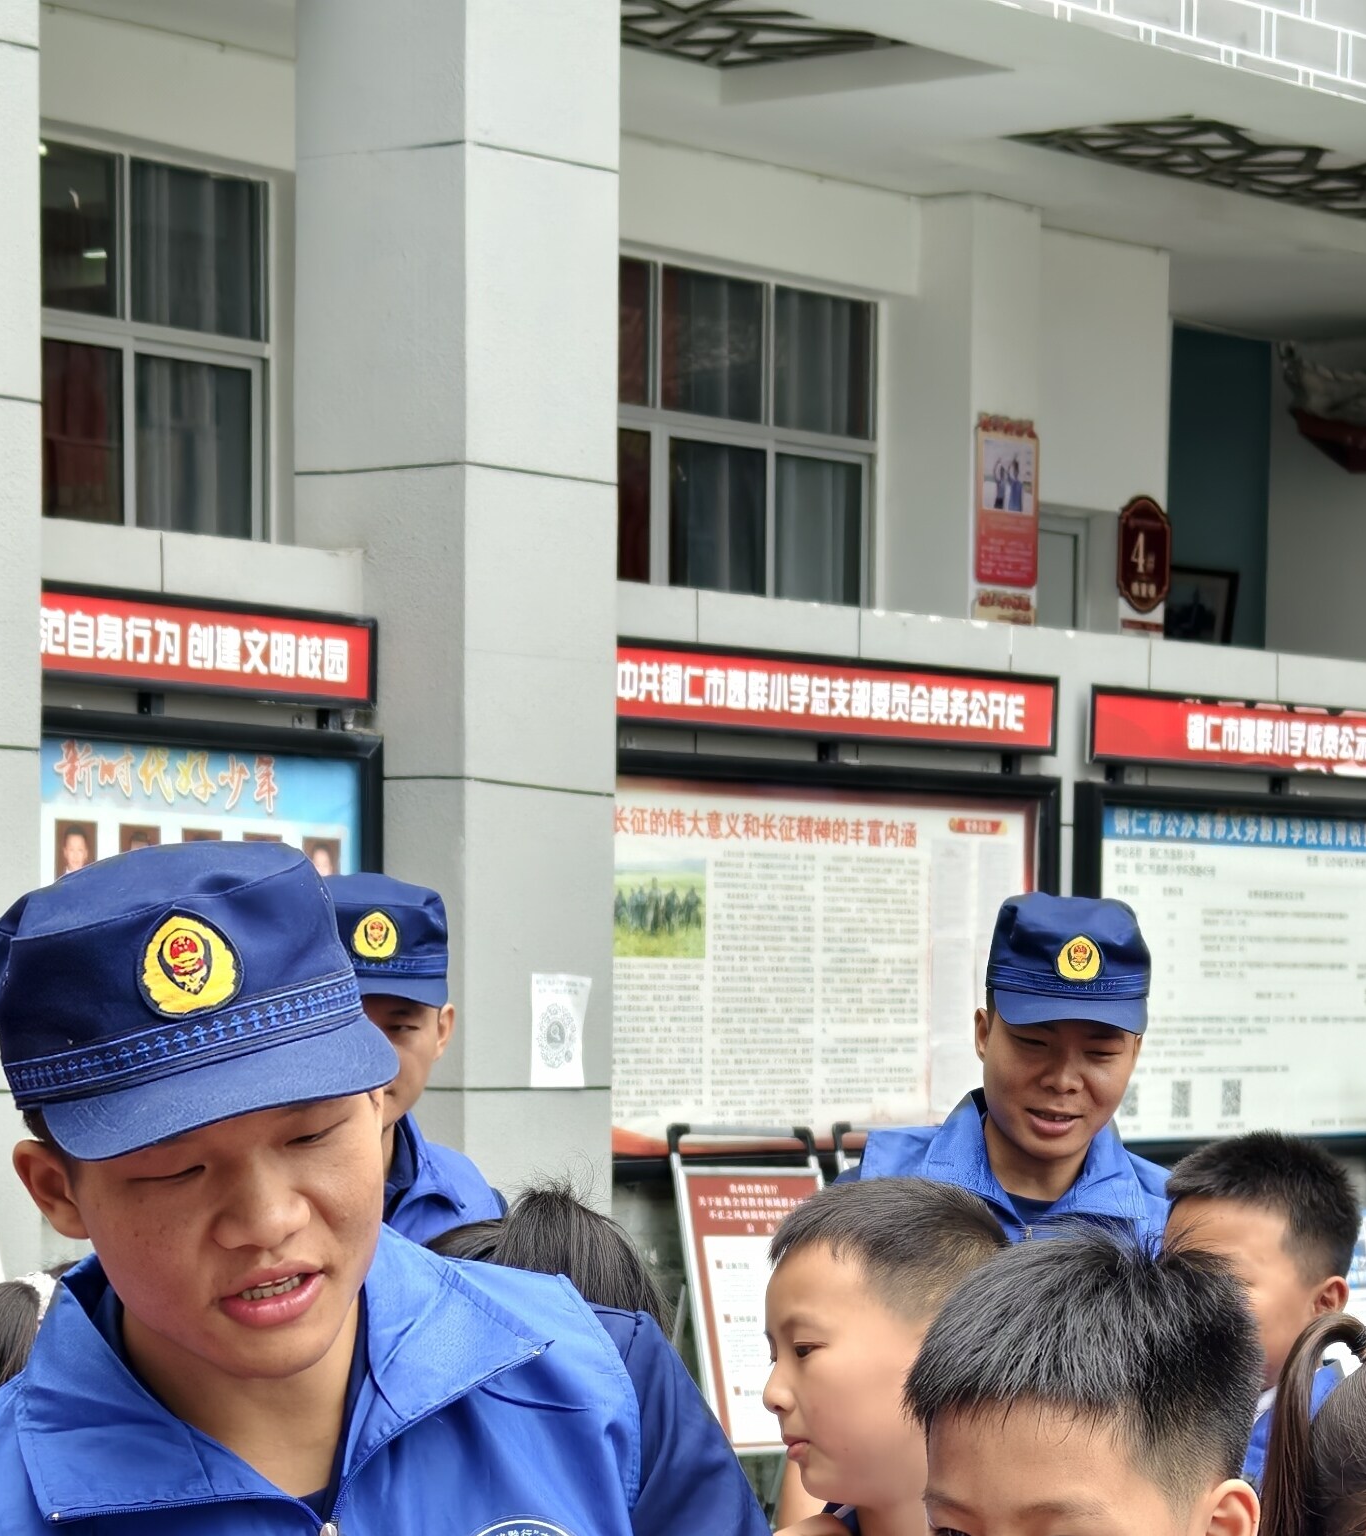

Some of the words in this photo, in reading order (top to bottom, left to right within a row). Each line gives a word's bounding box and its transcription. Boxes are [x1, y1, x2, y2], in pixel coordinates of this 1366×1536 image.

[187, 623, 349, 684] 创建文明校园
[54, 739, 278, 814] 新时代好少年
[614, 808, 918, 849] 长征的伟大意义和长征精神的丰富内涵
